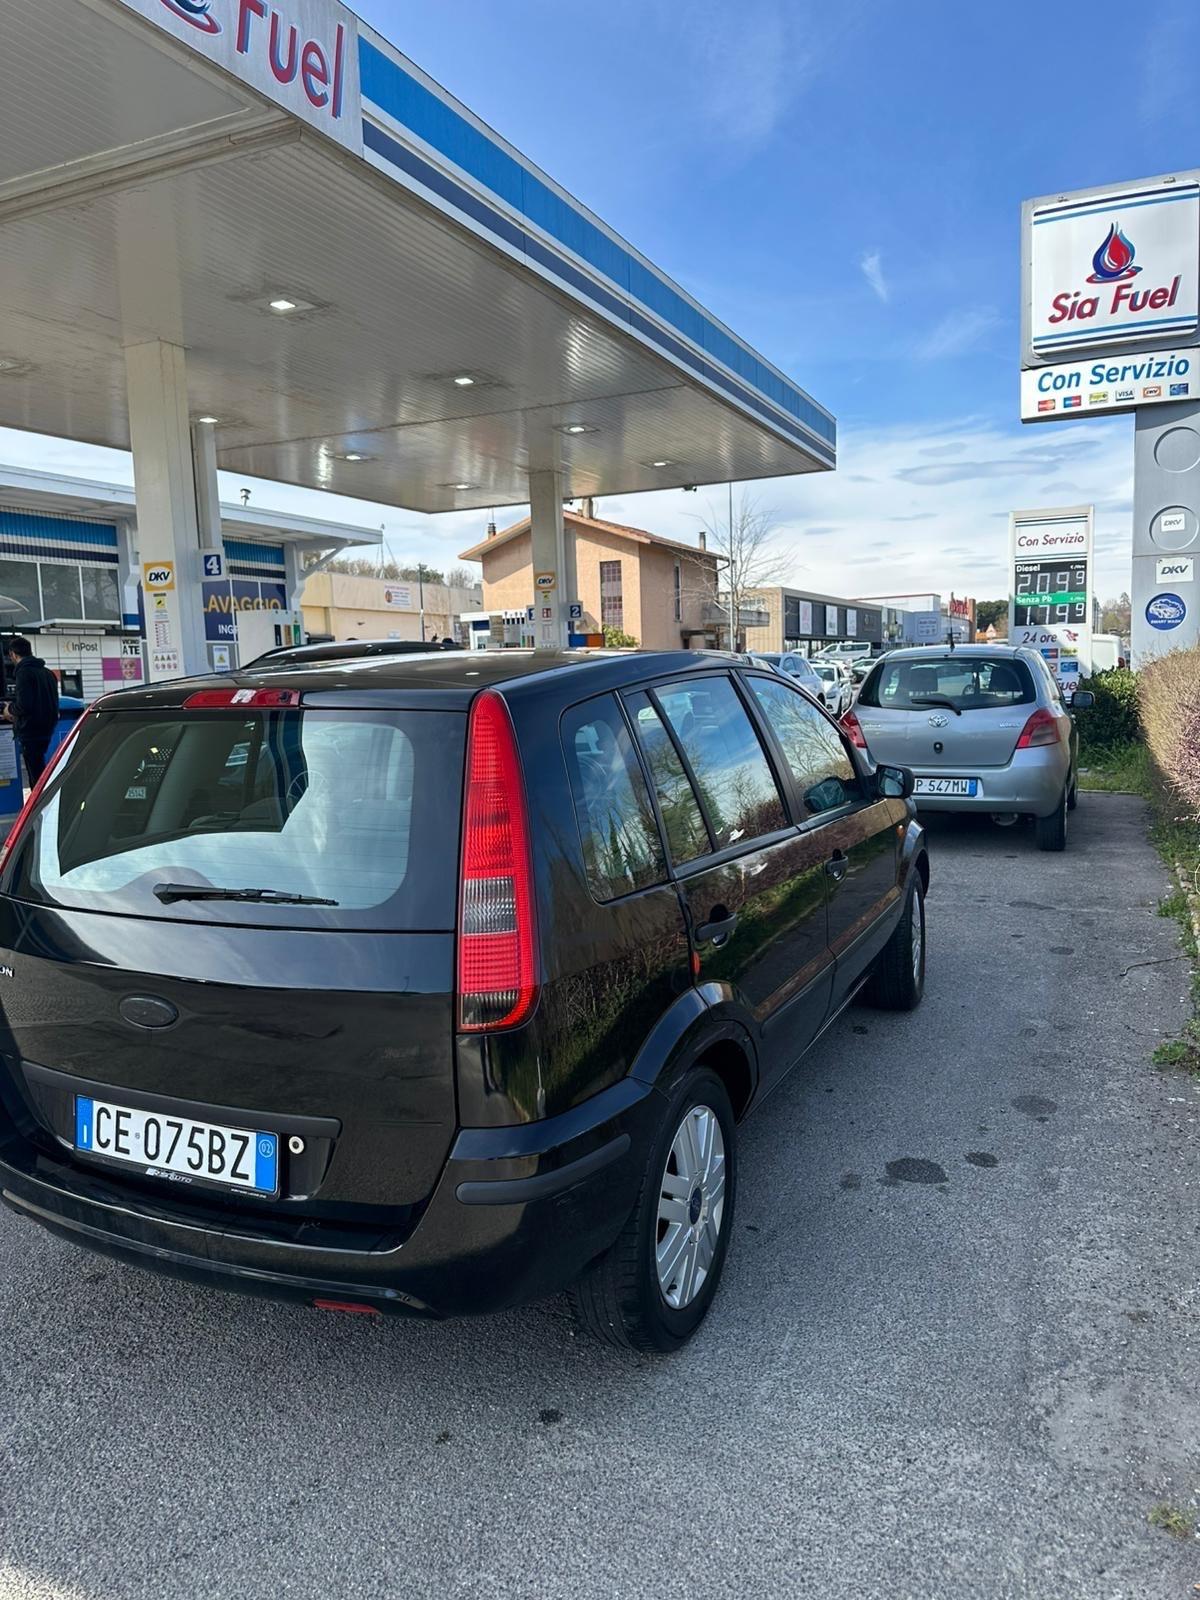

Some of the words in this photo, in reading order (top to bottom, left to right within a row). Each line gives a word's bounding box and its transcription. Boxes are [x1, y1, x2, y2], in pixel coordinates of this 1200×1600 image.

[1048, 289, 1099, 324] Sia
[1110, 274, 1182, 314] Fuel
[1037, 371, 1082, 392] Con
[1089, 354, 1190, 385] Servizio
[1117, 389, 1135, 398] VISA
[1163, 518, 1181, 527] DKV
[1018, 535, 1039, 547] Con
[1042, 531, 1085, 545] Servizio
[206, 556, 219, 575] 4
[1016, 564, 1041, 572] Diesel
[1161, 564, 1188, 575] DKV
[148, 571, 171, 581] DKV
[1016, 596, 1040, 604] Senza
[1041, 595, 1053, 603] Pb
[572, 606, 580, 618] 2
[1022, 631, 1037, 644] 24
[1040, 633, 1058, 643] ore
[71, 641, 98, 652] InPost
[928, 779, 968, 793] 547MW
[96, 1106, 132, 1155] CE
[144, 1117, 250, 1181] 075BZ
[260, 1141, 272, 1155] 02
